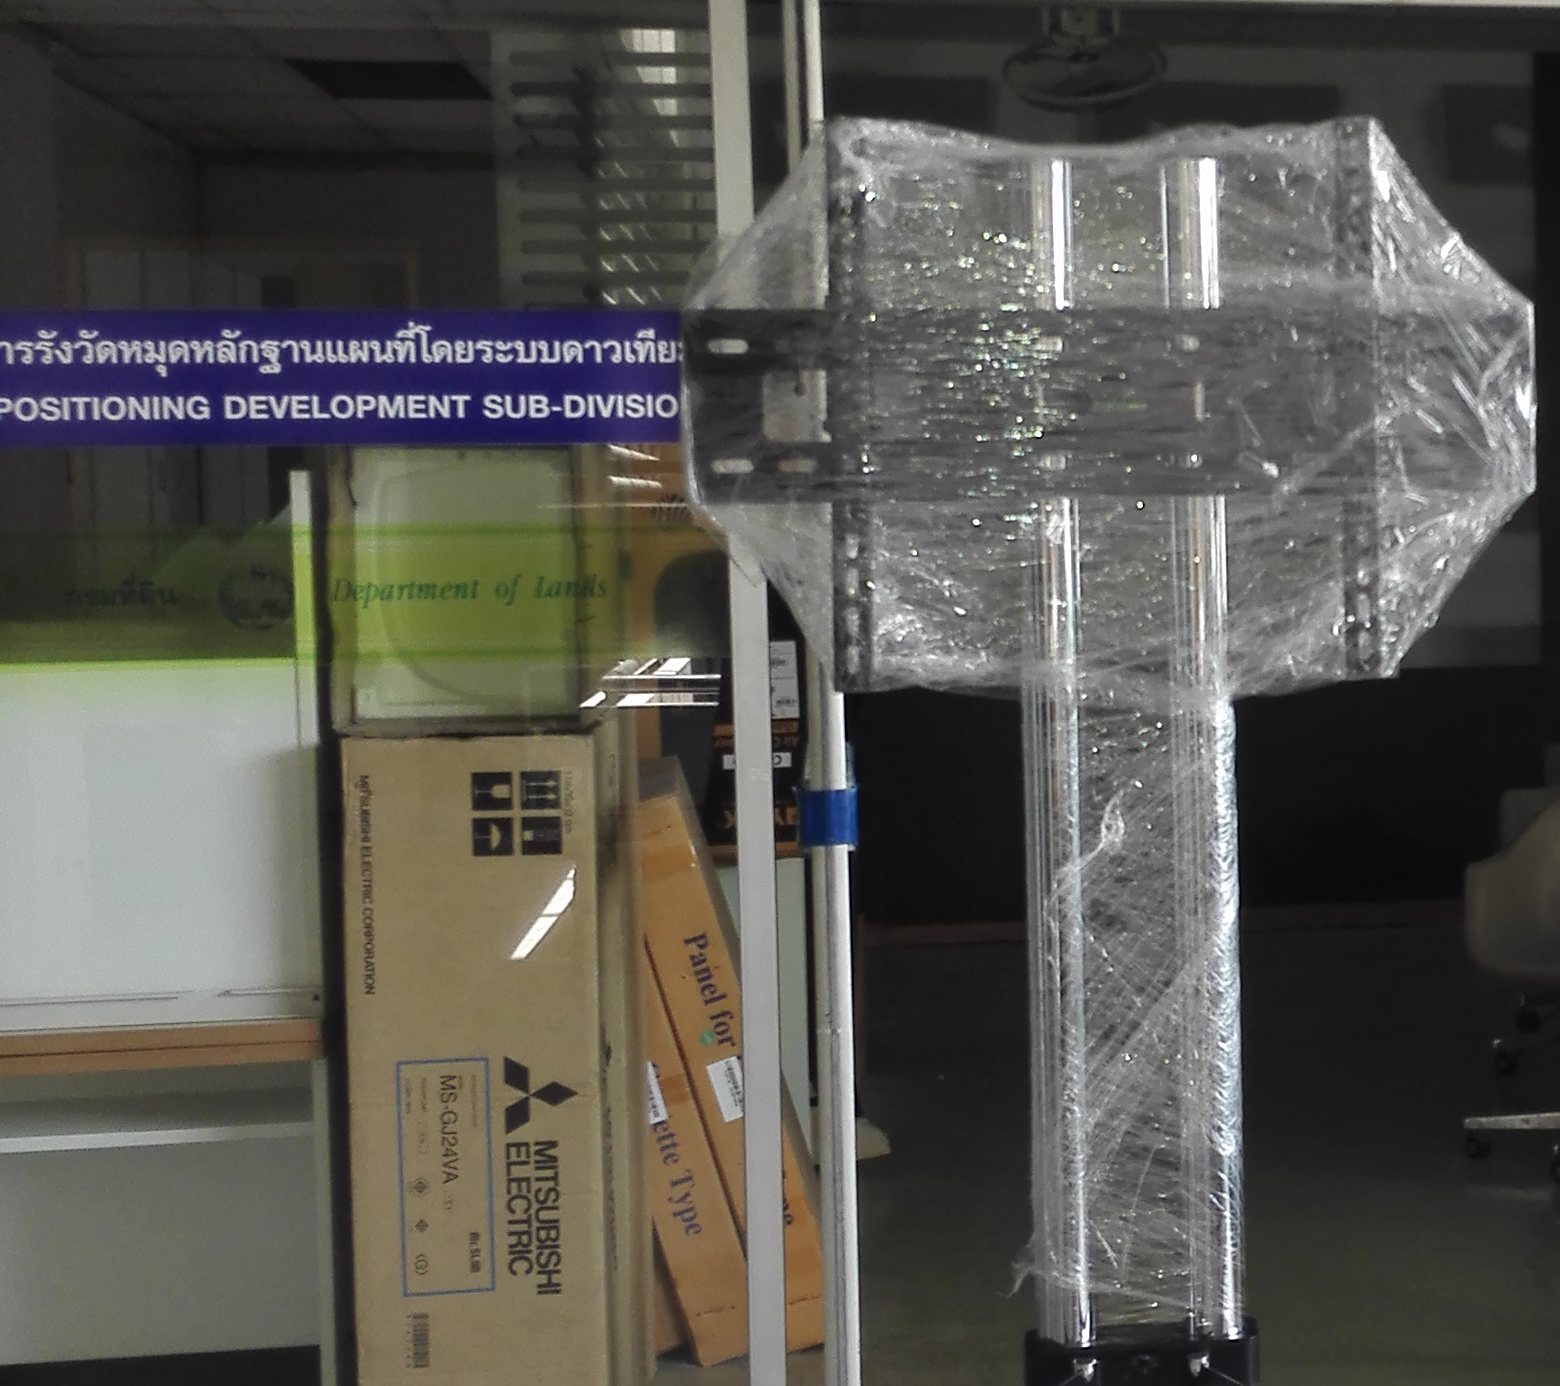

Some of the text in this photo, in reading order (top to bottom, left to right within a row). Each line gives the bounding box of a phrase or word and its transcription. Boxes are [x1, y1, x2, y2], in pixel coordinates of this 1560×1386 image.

[0, 321, 684, 377] ารรังวัดหมุดหลักฐานแผนที่โดยระบบดาวเทีย
[223, 394, 471, 421] DEVELOPMENT
[482, 393, 680, 420] SUB-DIVISIO
[332, 576, 480, 608] Department
[495, 574, 521, 607] of
[361, 845, 374, 904] ELECTRIC
[362, 907, 376, 995] CORPORATION
[684, 932, 728, 1006] Panel
[709, 1009, 738, 1047] for
[439, 1074, 460, 1184] MS-GJ24VA
[506, 1142, 532, 1277] ELECTRIC
[533, 1139, 561, 1296] MITSUBISHI
[667, 1169, 705, 1237] Type
